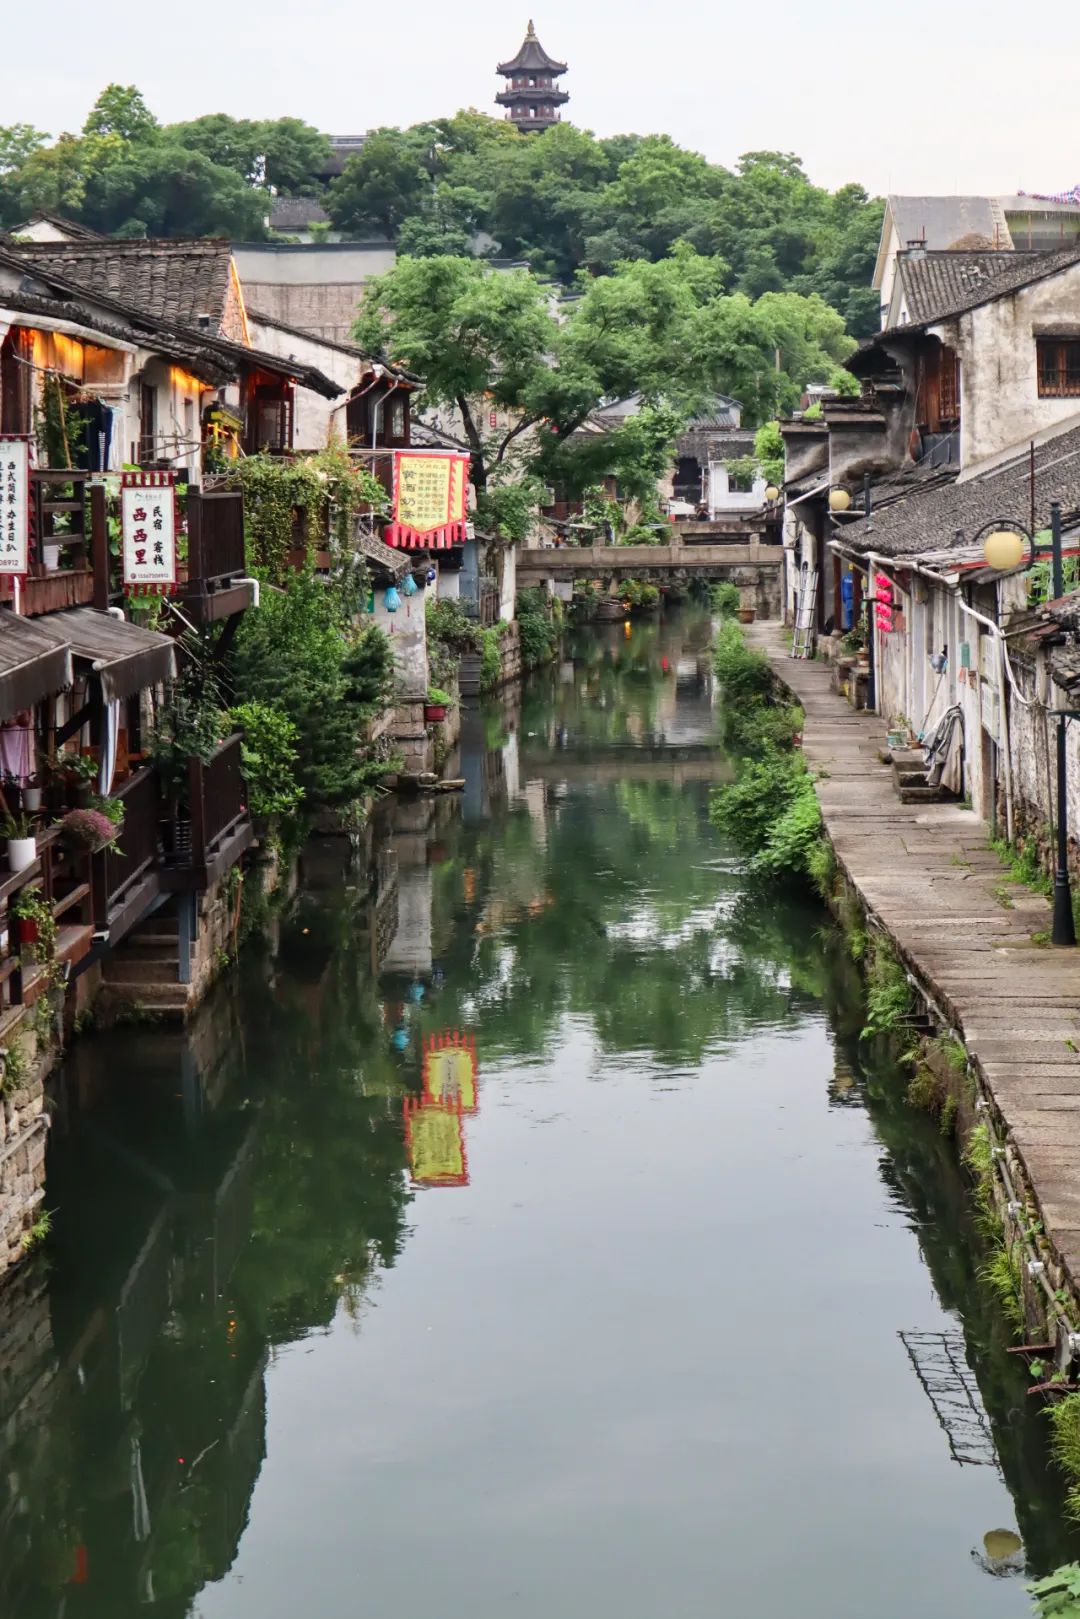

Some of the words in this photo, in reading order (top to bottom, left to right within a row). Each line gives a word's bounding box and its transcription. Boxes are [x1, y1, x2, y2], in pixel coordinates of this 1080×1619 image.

[7, 461, 16, 504] 西式简餐
[152, 505, 163, 531] 民宿
[132, 507, 148, 566] 西西里
[153, 540, 164, 566] 客栈
